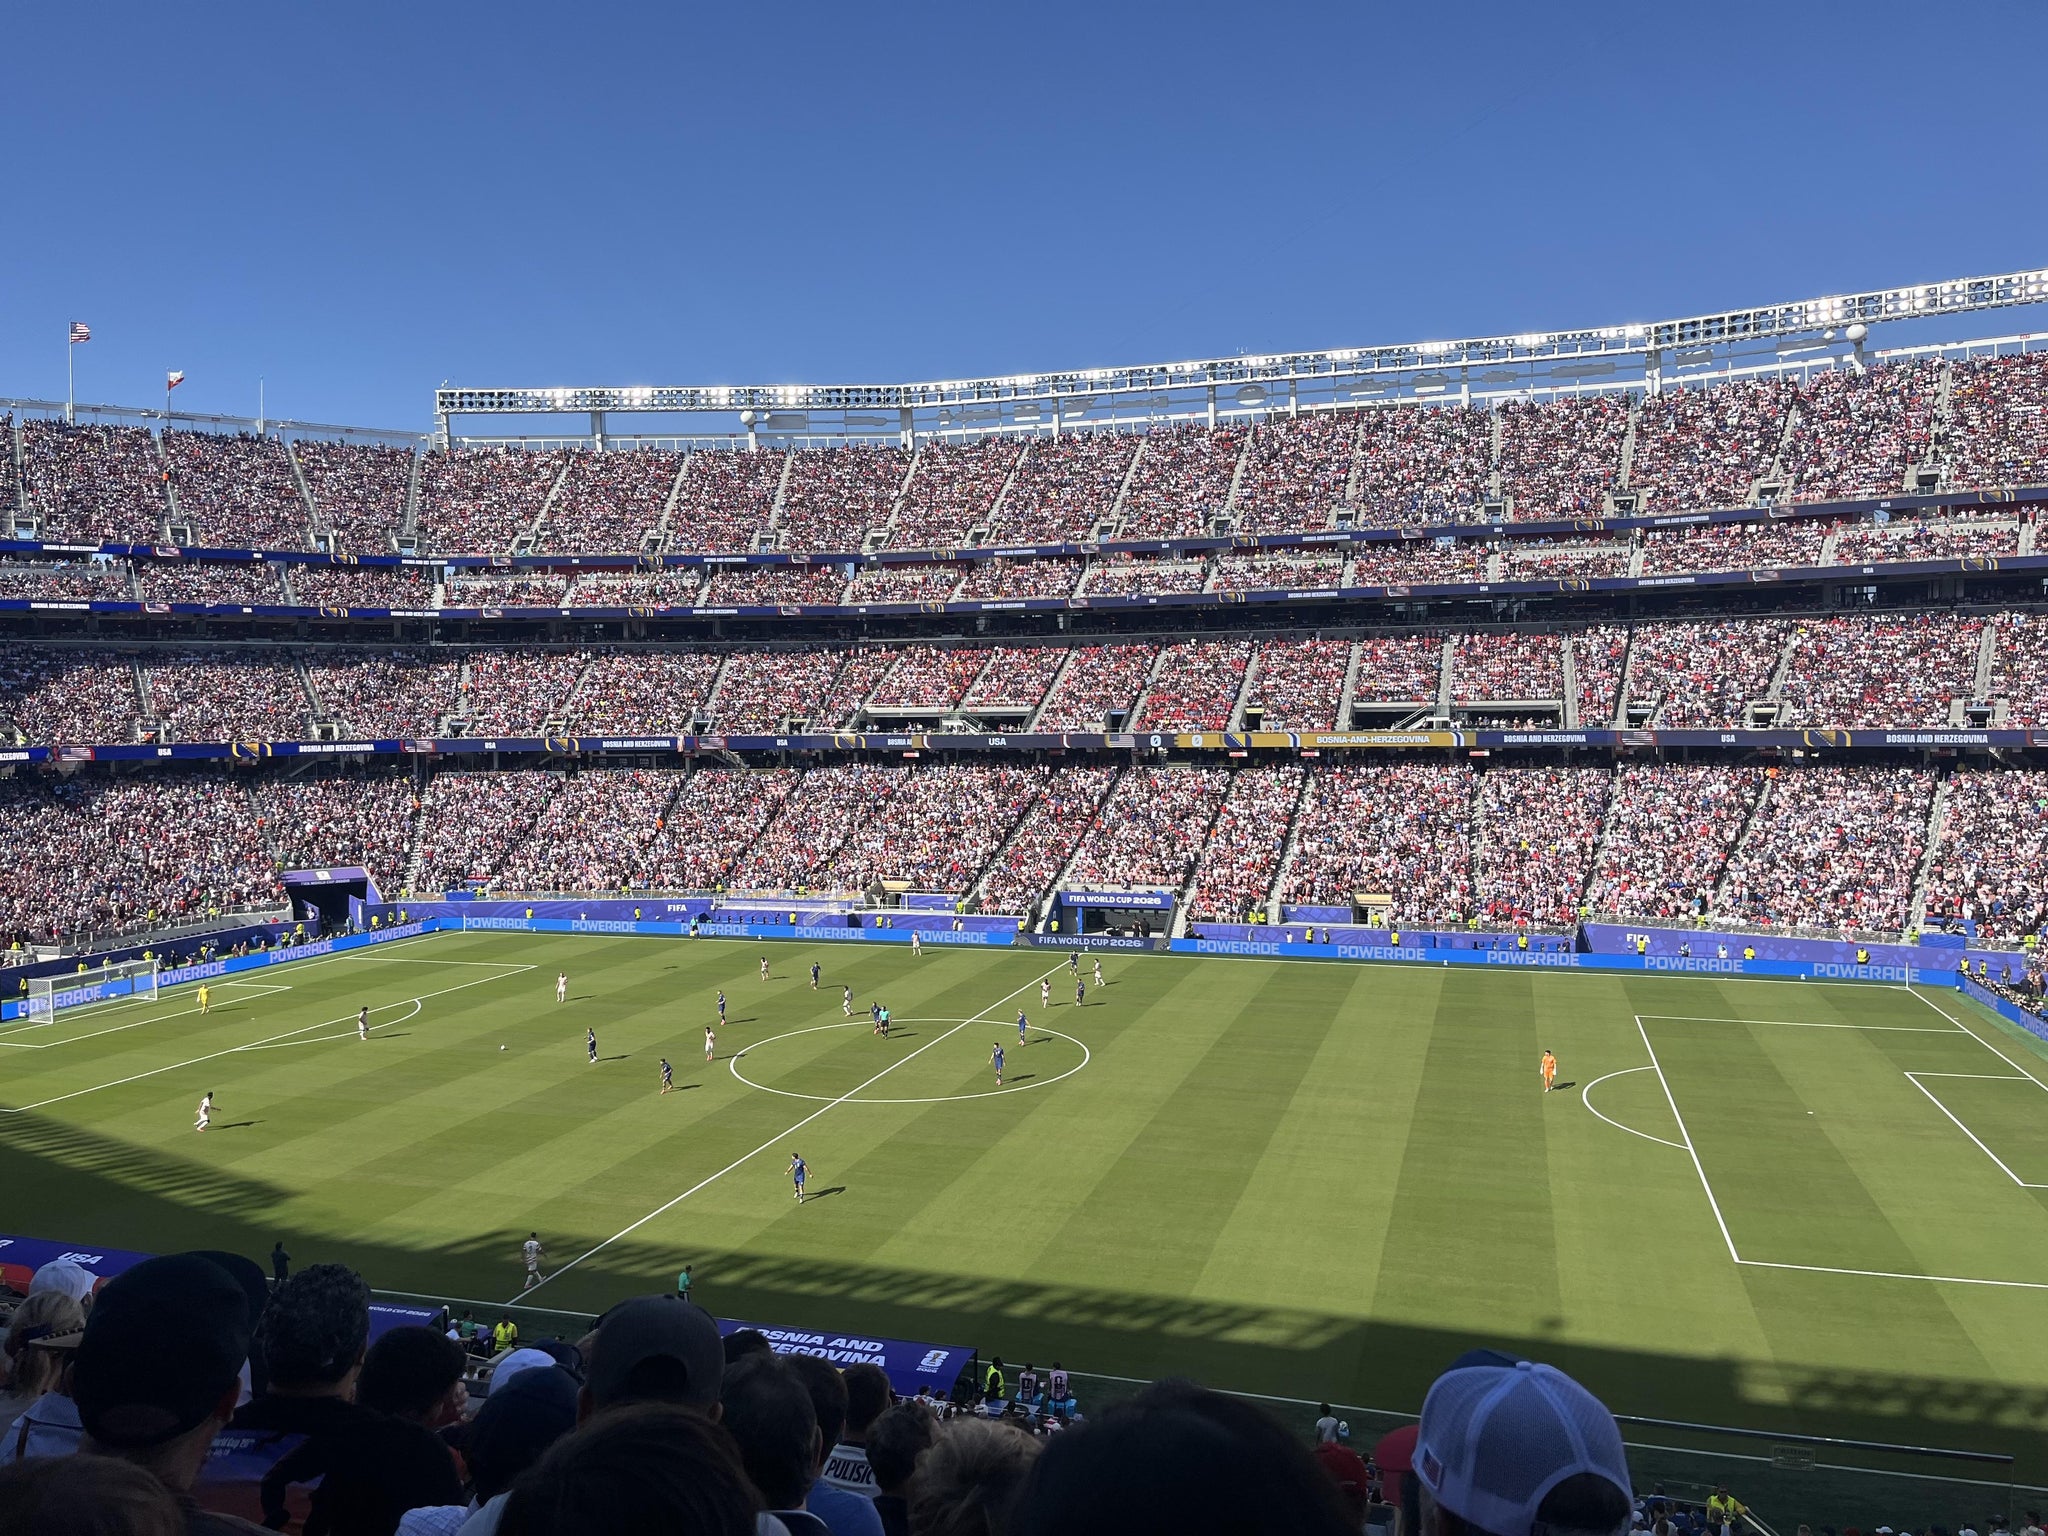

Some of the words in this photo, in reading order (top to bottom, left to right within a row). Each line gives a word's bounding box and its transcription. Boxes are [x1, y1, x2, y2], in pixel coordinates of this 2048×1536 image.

[635, 740, 671, 748] HERZEGOVINA
[988, 737, 1007, 746] USA
[1504, 735, 1528, 743] BOSNIA
[1528, 735, 1542, 743] AND
[1721, 734, 1735, 742] USA
[1886, 735, 1915, 743] BOSNIA
[1916, 735, 1933, 743] AND
[1934, 735, 1988, 743] HERZEGOVINA
[158, 748, 172, 756] USA
[335, 744, 374, 752] HERZEGOVINA
[1133, 897, 1162, 905] 2026
[667, 904, 687, 912] FIFA
[466, 918, 529, 929] POWERADE
[572, 920, 637, 932] POWERADE
[681, 923, 749, 936] PWERADE
[370, 922, 423, 942] POWERADE
[795, 927, 866, 940] POWERADE
[1058, 937, 1090, 945] WORLD
[1091, 938, 1109, 946] CUP
[1109, 939, 1141, 947] 2026
[1197, 940, 1280, 955] POWERADE
[270, 940, 333, 963] POWERADE
[1337, 945, 1426, 961] POWERADE
[1487, 950, 1580, 966] POWERADE
[1644, 955, 1744, 973] POWERADE
[1813, 963, 1920, 982] POWERADE
[57, 1252, 103, 1265] USA
[827, 1337, 884, 1352] AND
